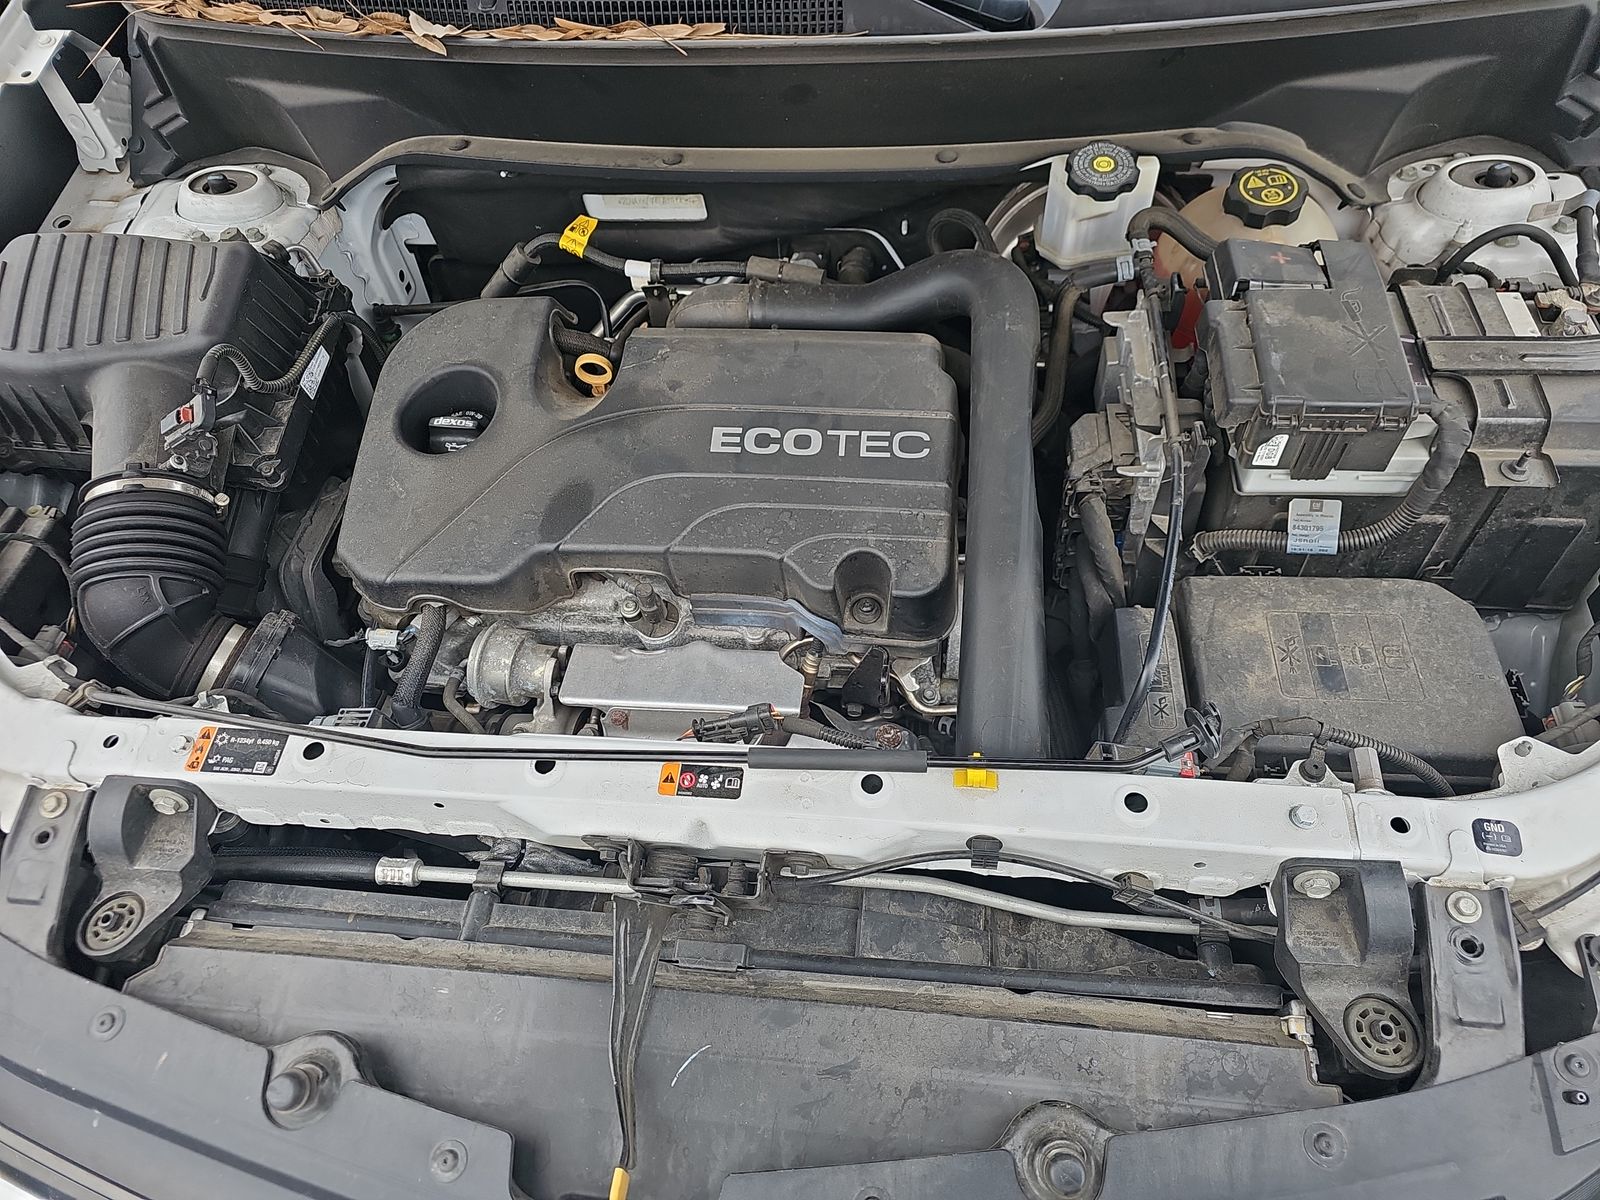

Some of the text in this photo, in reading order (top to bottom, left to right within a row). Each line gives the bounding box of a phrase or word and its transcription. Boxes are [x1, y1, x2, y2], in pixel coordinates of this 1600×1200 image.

[433, 416, 474, 427] dexos
[709, 426, 931, 459] ECOTEC
[229, 737, 255, 746] R-1234yf
[272, 739, 280, 747] kg
[221, 756, 234, 764] PAG
[1483, 822, 1505, 833] GND
